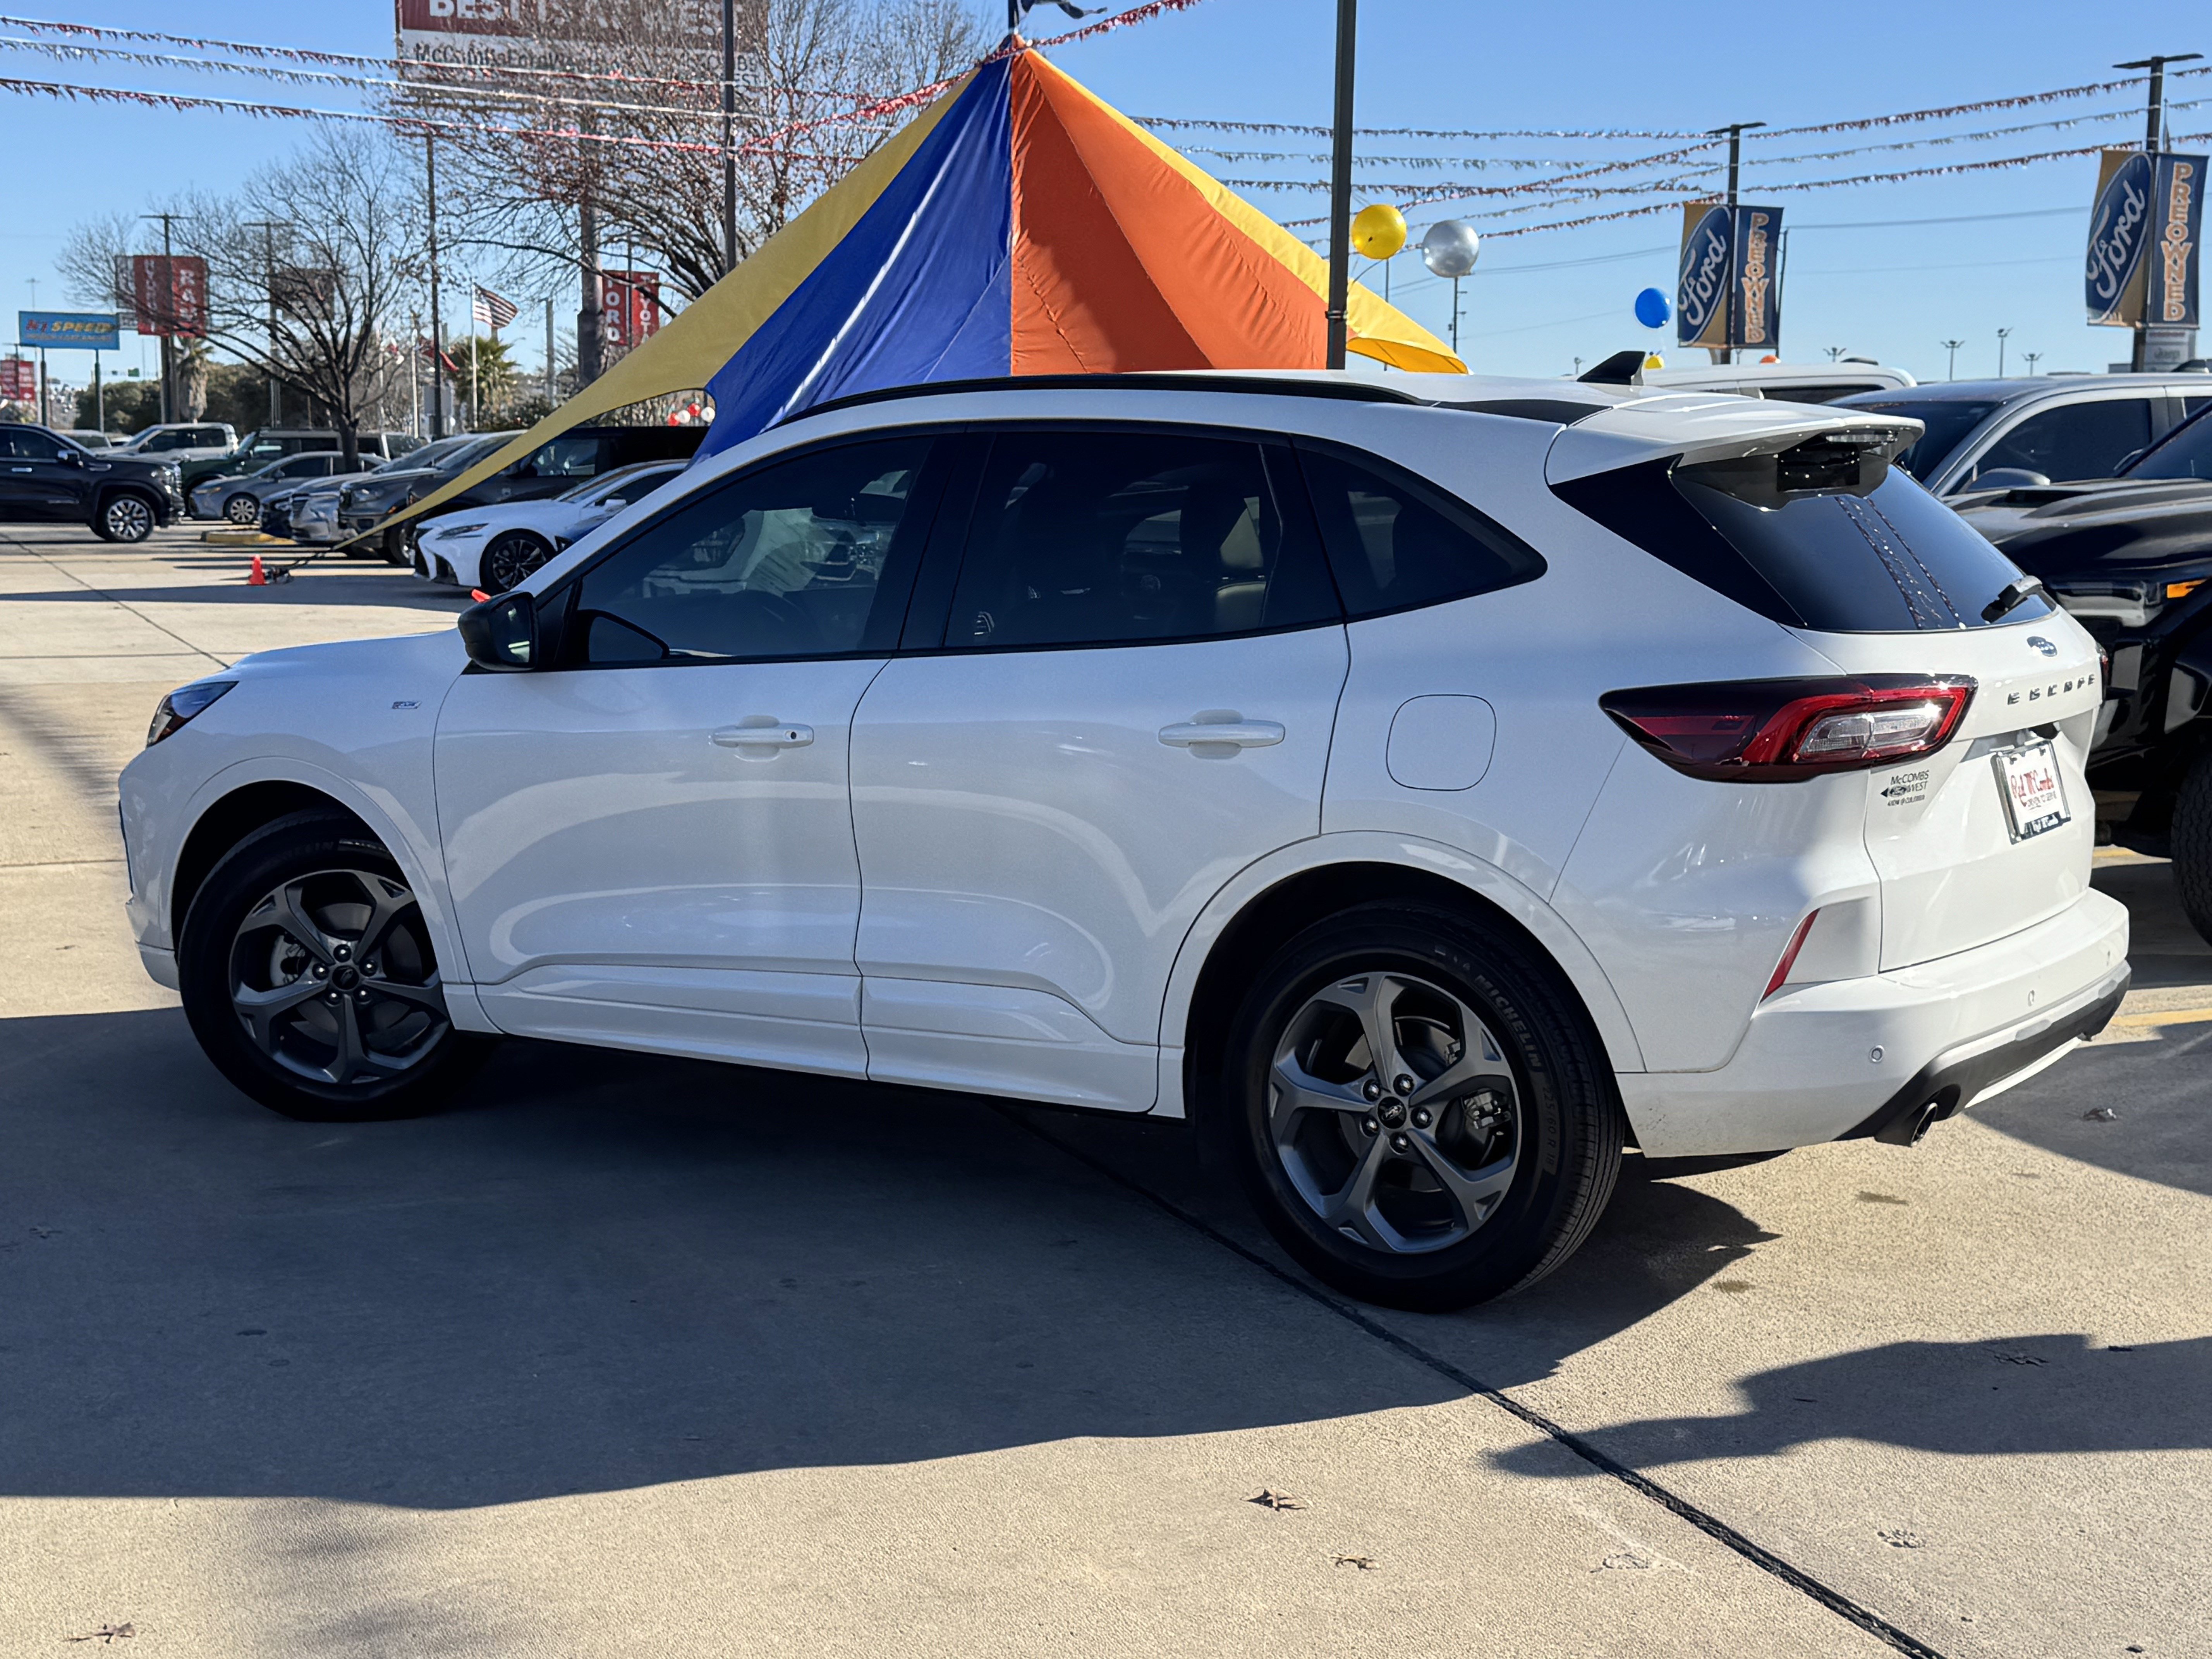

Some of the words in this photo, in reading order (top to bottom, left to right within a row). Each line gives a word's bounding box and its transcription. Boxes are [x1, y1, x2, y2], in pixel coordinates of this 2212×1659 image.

[1678, 228, 1727, 326] Ford
[2087, 180, 2145, 300] Ford
[640, 275, 652, 344] TYOTA
[2007, 673, 2095, 706] ESCAPE
[1474, 974, 1542, 1067] MICHELIN
